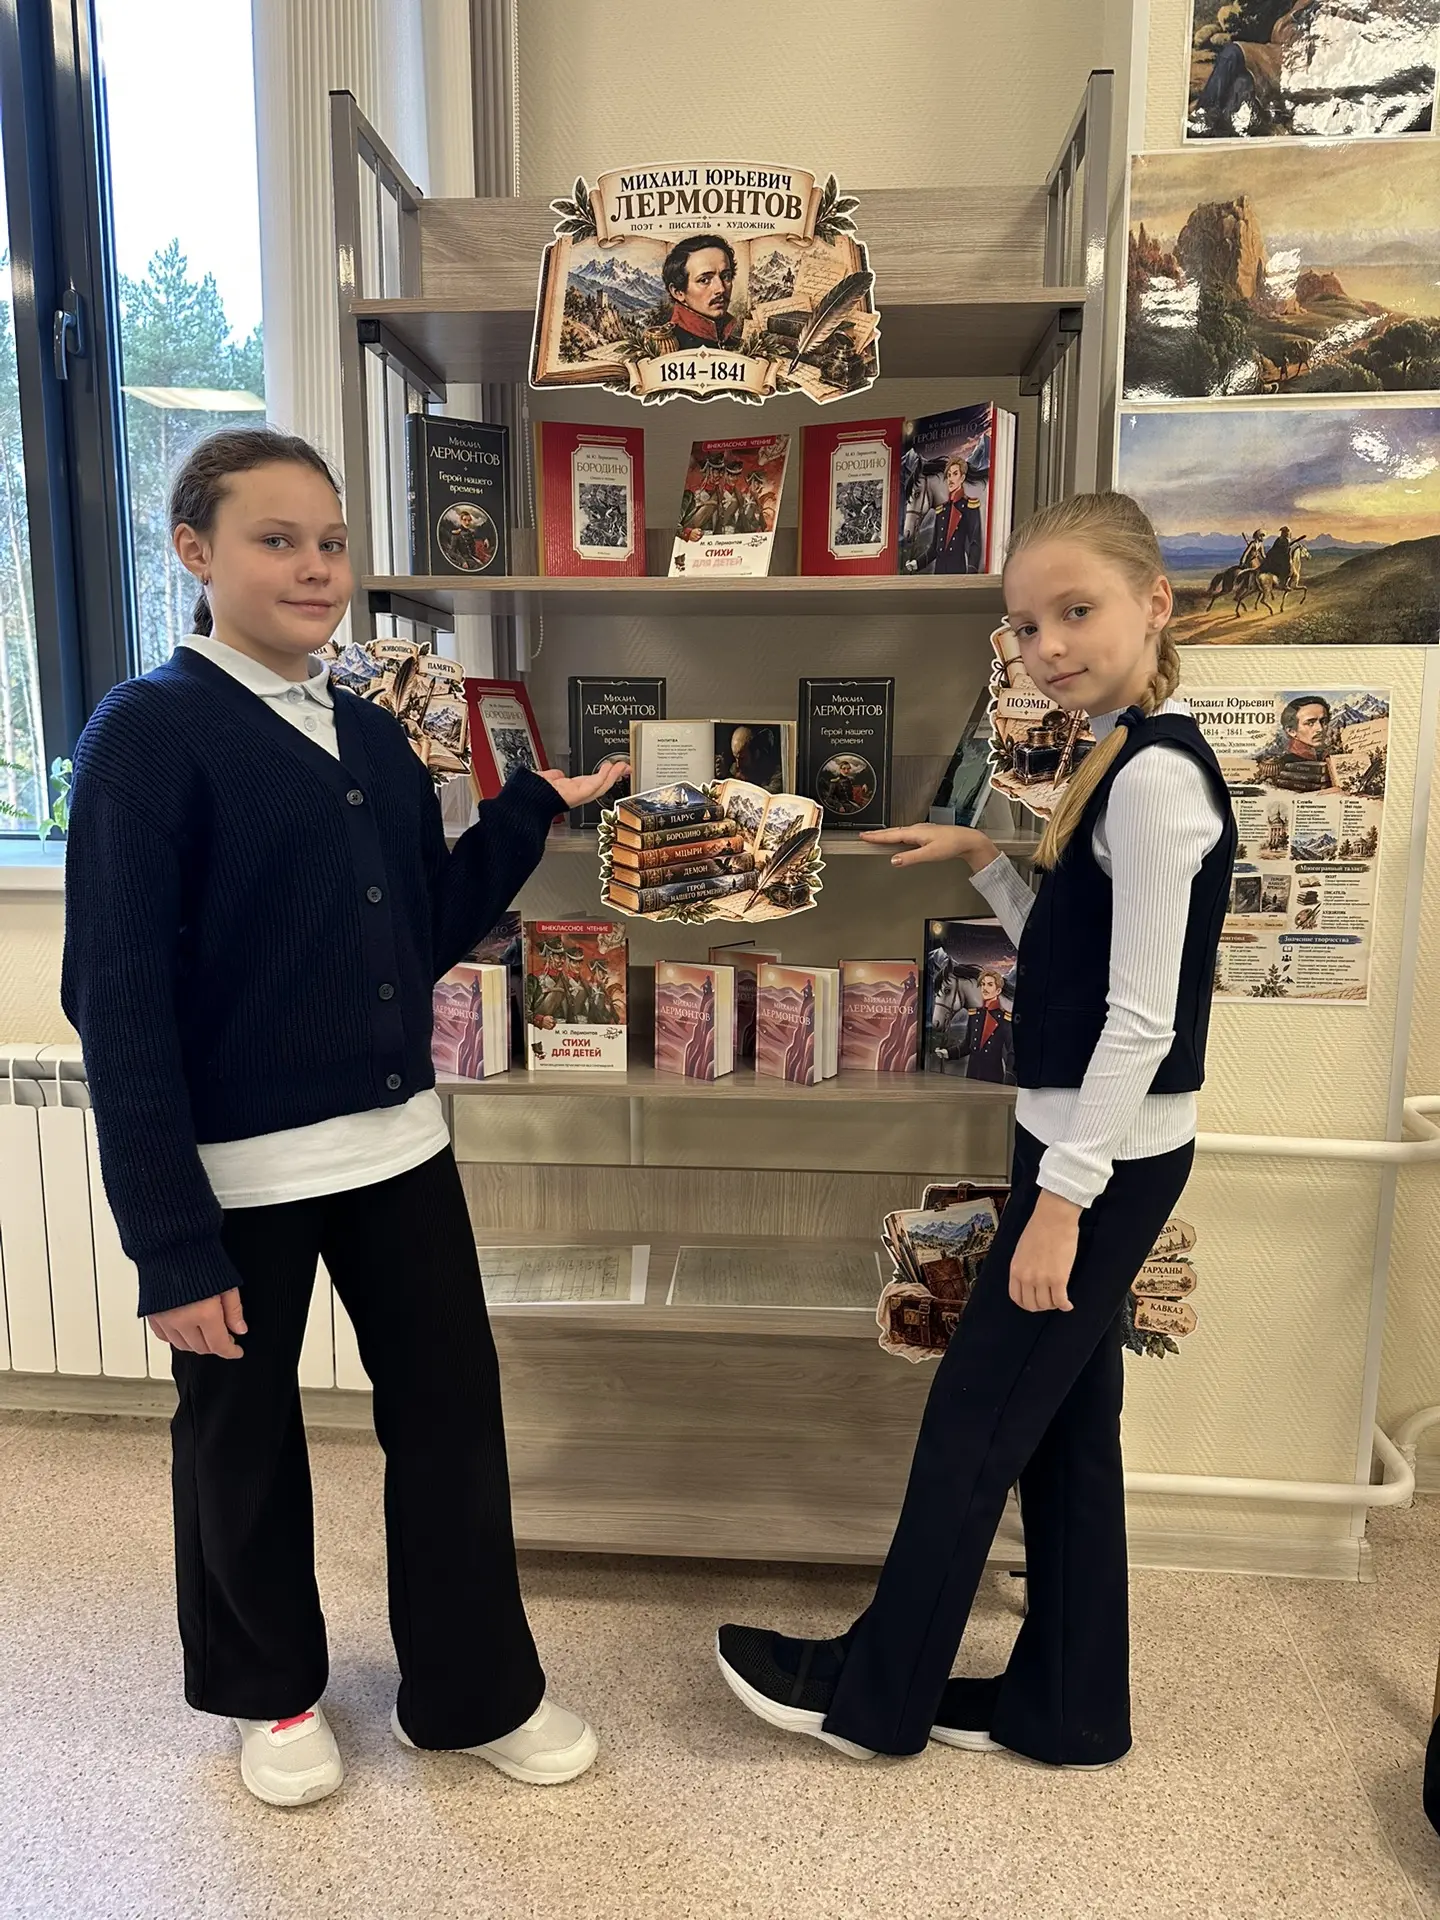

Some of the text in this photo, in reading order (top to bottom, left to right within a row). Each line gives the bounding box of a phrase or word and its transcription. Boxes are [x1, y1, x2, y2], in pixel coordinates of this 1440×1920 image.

[620, 169, 792, 192] МИХАИЛ ЮРЬЕВИЧ
[610, 189, 802, 222] ЛЕРМОНТОВ
[631, 221, 776, 231] ПОЭТ ПИСАТЕЛЬ ХУДОЖНИК
[706, 441, 747, 449] ВНЕКЛАССНОЕ
[430, 445, 500, 466] ЛЕРМОНТОВ
[576, 461, 629, 475] БОРОДИНО
[835, 457, 887, 471] БОРОДИНО
[439, 471, 493, 486] Герой нашего
[449, 484, 484, 495] времени
[705, 548, 734, 558] СТИХИ
[381, 645, 414, 655] ЖИВОПИСЬ
[427, 662, 456, 674] ПАМЯТЬ
[1006, 697, 1050, 710] ПОЭМЫ
[1227, 697, 1275, 710] Юрьевич
[585, 704, 656, 716] ЛЕРМОНТОВ
[813, 704, 883, 716] ЛЕРМОНТОВ
[1189, 711, 1276, 725] рмонтов
[593, 726, 617, 737] Герой
[821, 726, 875, 737] Герой нашего
[1203, 728, 1219, 736] 1814
[1227, 728, 1242, 736] 1841
[604, 737, 630, 745] време
[830, 738, 864, 747] времени
[670, 813, 696, 823] ПАРУС
[666, 830, 701, 842] БОРОДИНО
[675, 847, 703, 858] МЦЫРИ
[683, 865, 708, 877] ДЕМОН
[686, 882, 706, 892] ГЕРОЙ
[670, 887, 723, 902] НАШЕГО ВРЕМЕНИ
[541, 924, 609, 933] ВНЕКЛАССНОЕ ЧТЕНИЕ
[434, 1005, 480, 1021] ЛЕРМОНТОВ
[660, 1005, 711, 1022] ЛЕРМОНТОВ
[846, 1004, 914, 1015] ЛЕРМОНТОВ
[761, 1008, 811, 1026] ЛЕРМОНТОВ
[562, 1038, 591, 1047] СТИХИ
[551, 1047, 602, 1058] ДЛЯ ДЕТЕЙ
[1142, 1266, 1183, 1275] ТАРХАНЫ
[1150, 1303, 1184, 1315] КАВКАЗ
